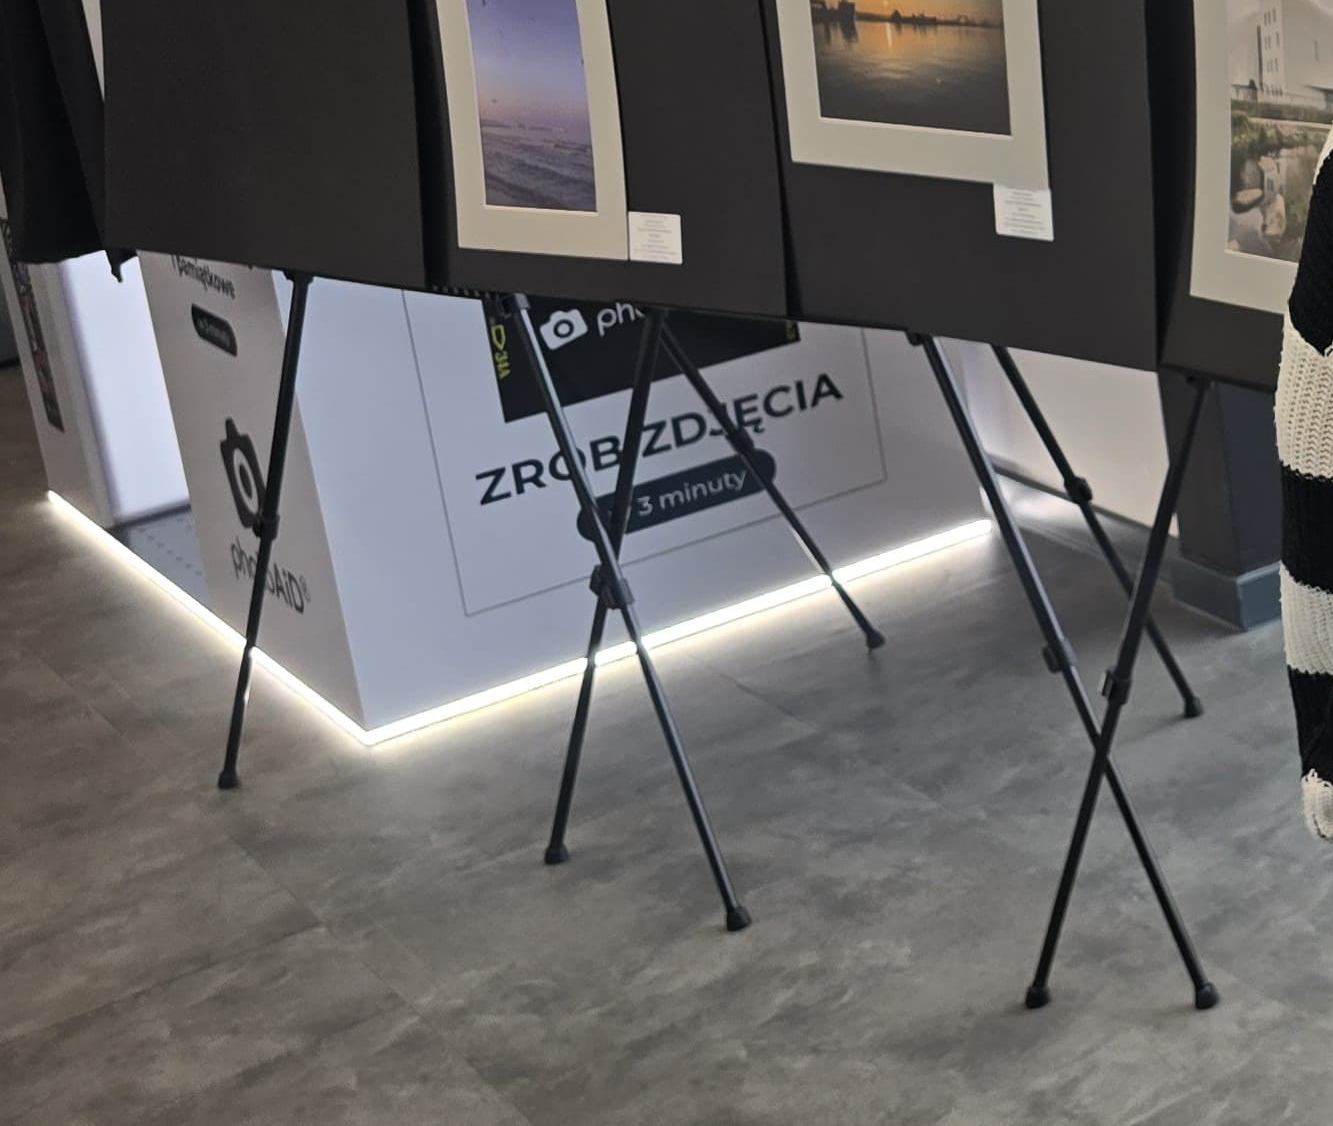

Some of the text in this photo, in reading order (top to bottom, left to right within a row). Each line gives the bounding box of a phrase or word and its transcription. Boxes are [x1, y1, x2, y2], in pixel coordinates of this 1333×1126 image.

[639, 469, 748, 517] 3 minuty
[231, 535, 304, 615] phooAiD
